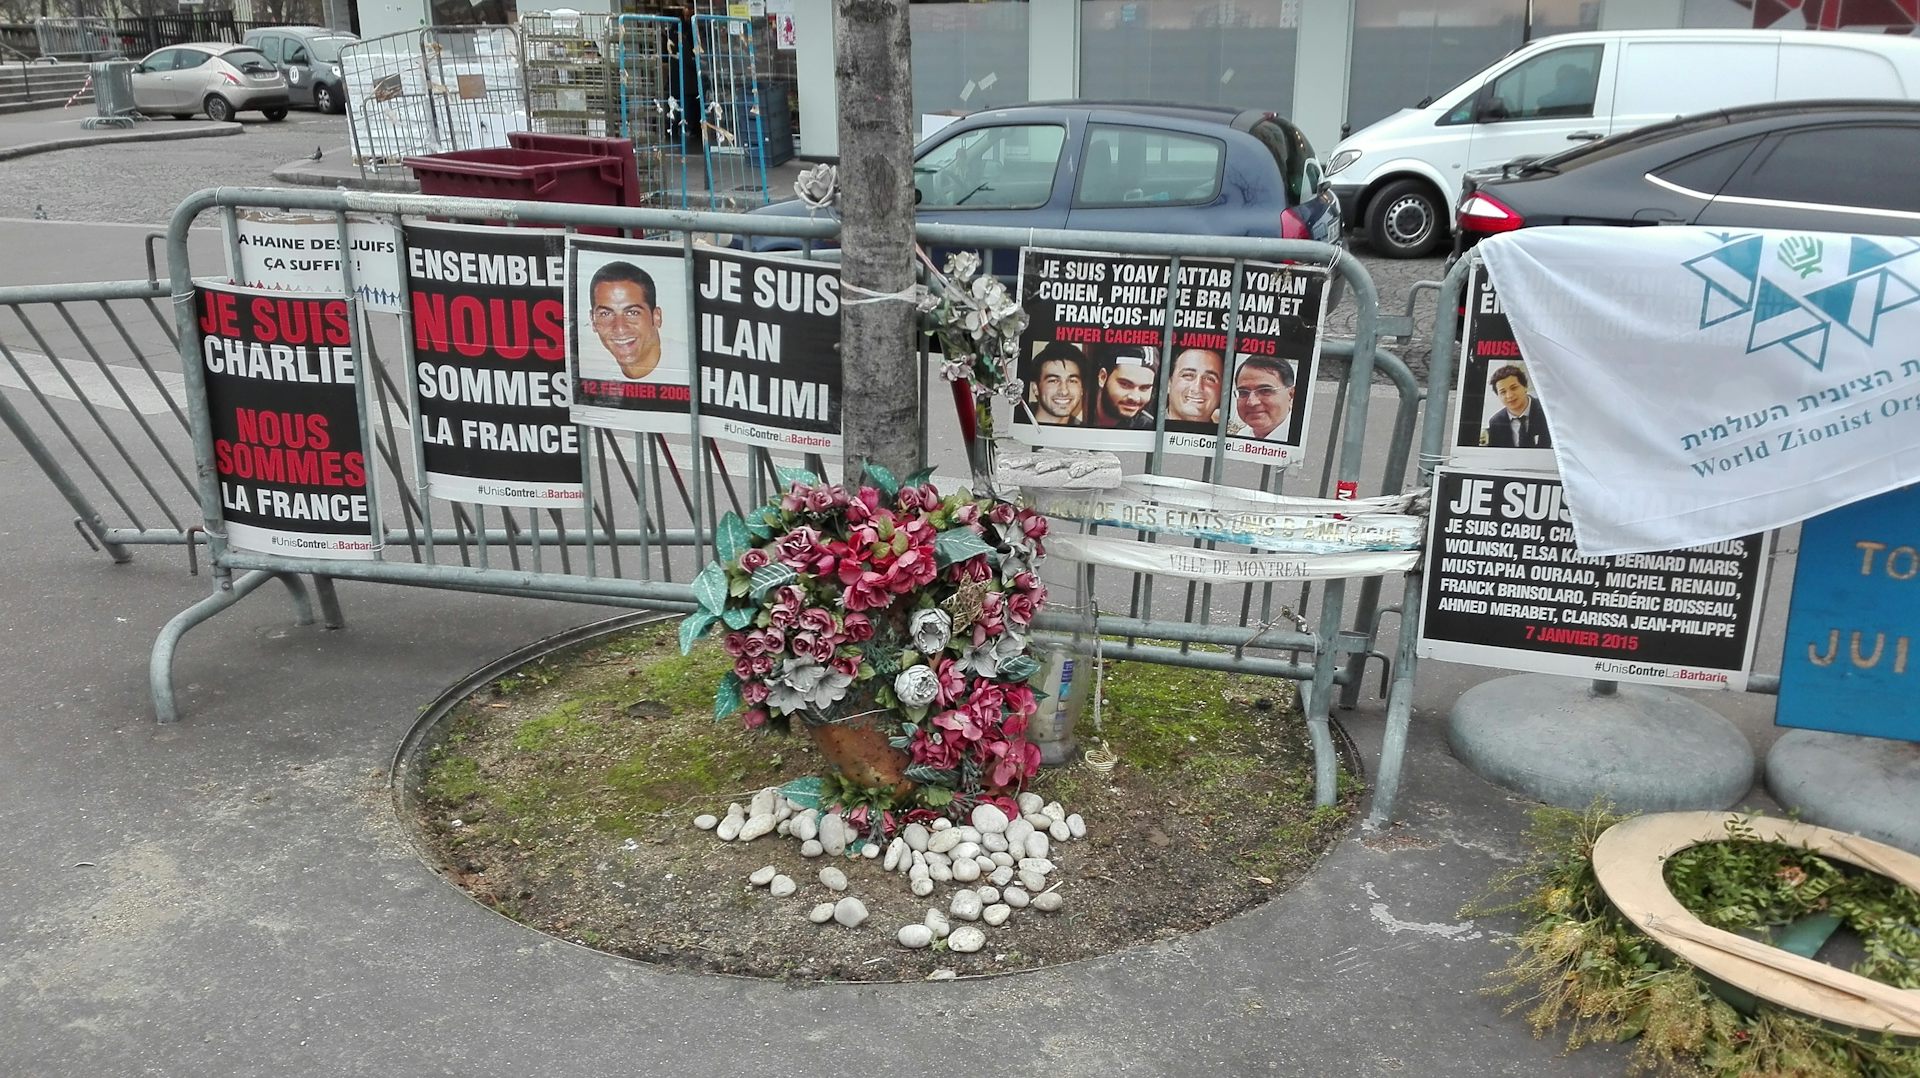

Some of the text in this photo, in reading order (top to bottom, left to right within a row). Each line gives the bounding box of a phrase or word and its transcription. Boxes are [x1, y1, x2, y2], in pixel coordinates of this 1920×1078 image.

[238, 234, 249, 245] A
[252, 235, 305, 250] HAINE
[350, 239, 395, 253] JUIFS
[264, 257, 361, 271] ÇA SUFFI !
[408, 247, 564, 287] ENSEMBLE
[1039, 259, 1060, 279] JE
[1065, 261, 1106, 282] SUIS
[1111, 264, 1159, 284] YOAV
[1245, 271, 1308, 296] YOHAN
[700, 258, 840, 317] JE SUIS
[1039, 281, 1104, 305] COHEN,
[1280, 298, 1304, 317] ET
[200, 291, 350, 346] JE SUIS
[412, 290, 565, 360] NOUS
[701, 313, 781, 364] ILAN
[1054, 304, 1281, 337] FRANÇOIS-MCHEL SAADA
[203, 334, 356, 384] CHARLIE
[1055, 326, 1101, 343] HYPER
[1105, 329, 1163, 347] CACHER,
[1241, 337, 1277, 355] 2015
[1477, 341, 1520, 356] MUSE
[417, 361, 571, 408] SOMMES
[581, 380, 691, 401] 12 FÉVRIER 2006
[701, 366, 829, 422] HALIMI
[1797, 369, 1894, 412] הציונית
[236, 407, 330, 450] NOUS
[421, 414, 579, 454] LA FRANCE
[724, 423, 831, 448] #UnisContreLaBarbarie
[1169, 435, 1288, 459] #UnisConeLaBarbarie
[1681, 404, 1790, 451] העולמית
[1690, 440, 1771, 478] World
[1778, 408, 1873, 452] Zionist
[216, 440, 366, 488] SOMMES
[222, 481, 369, 522] LA FRANCE
[1450, 478, 1494, 516] JE
[1122, 505, 1157, 526] DES
[1166, 510, 1224, 533] ETATS
[1444, 518, 1463, 534] JE
[1465, 519, 1498, 537] SUIS
[1500, 522, 1546, 544] CABU,
[1549, 526, 1577, 543] CHA
[271, 536, 372, 550] #UnisContreLaBarbari
[1445, 538, 1519, 562] WOLINSKI,
[1521, 543, 1559, 562] ELSA
[1614, 553, 1686, 574] BERNARD
[1687, 557, 1744, 580] MARIS,
[1855, 540, 1919, 580] TO
[1169, 553, 1311, 578] VILLE DE MONTREAL
[1441, 557, 1741, 601] MUSTAPHA OURAAD, MICHEL RENAUD,
[1438, 597, 1735, 638] AHMED MERABET, CLARISSA JEAN-PHILIPPE
[1440, 577, 1738, 621] FRANCK BRINSOLARO, FRÉDÉRIC BOISSEAU,
[1525, 625, 1639, 651] 7 JANVIER 2015
[1807, 628, 1910, 674] JUI
[1594, 661, 1728, 683] #UnisContreLaBarbarie
